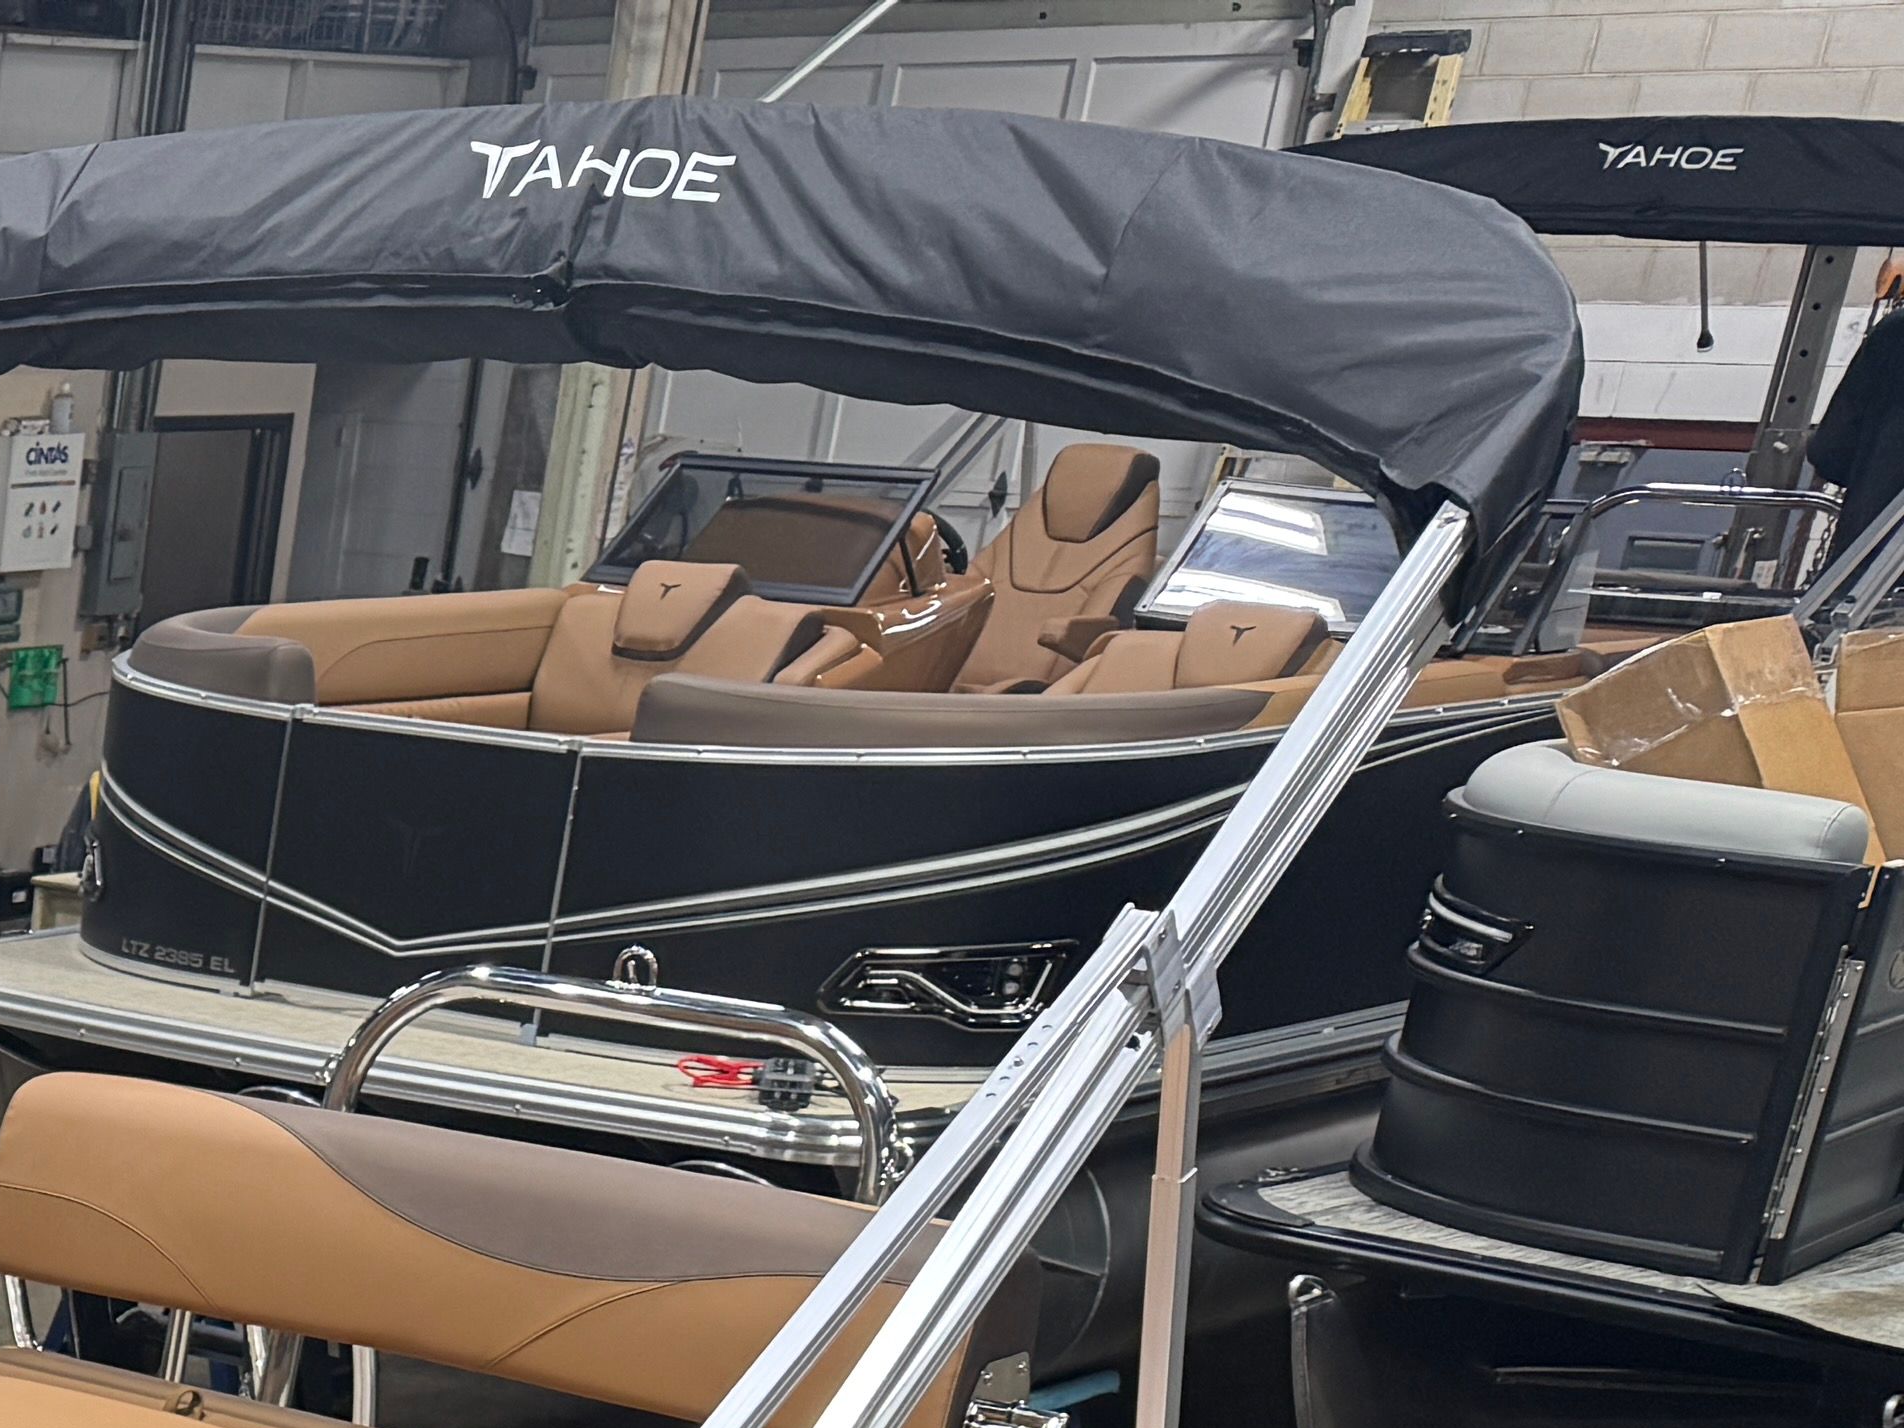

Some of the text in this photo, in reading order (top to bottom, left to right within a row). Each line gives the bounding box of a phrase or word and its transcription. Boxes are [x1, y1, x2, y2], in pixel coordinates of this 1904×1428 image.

[470, 139, 737, 203] TAHOE
[1598, 142, 1745, 171] TAHOE
[210, 956, 235, 973] EL
